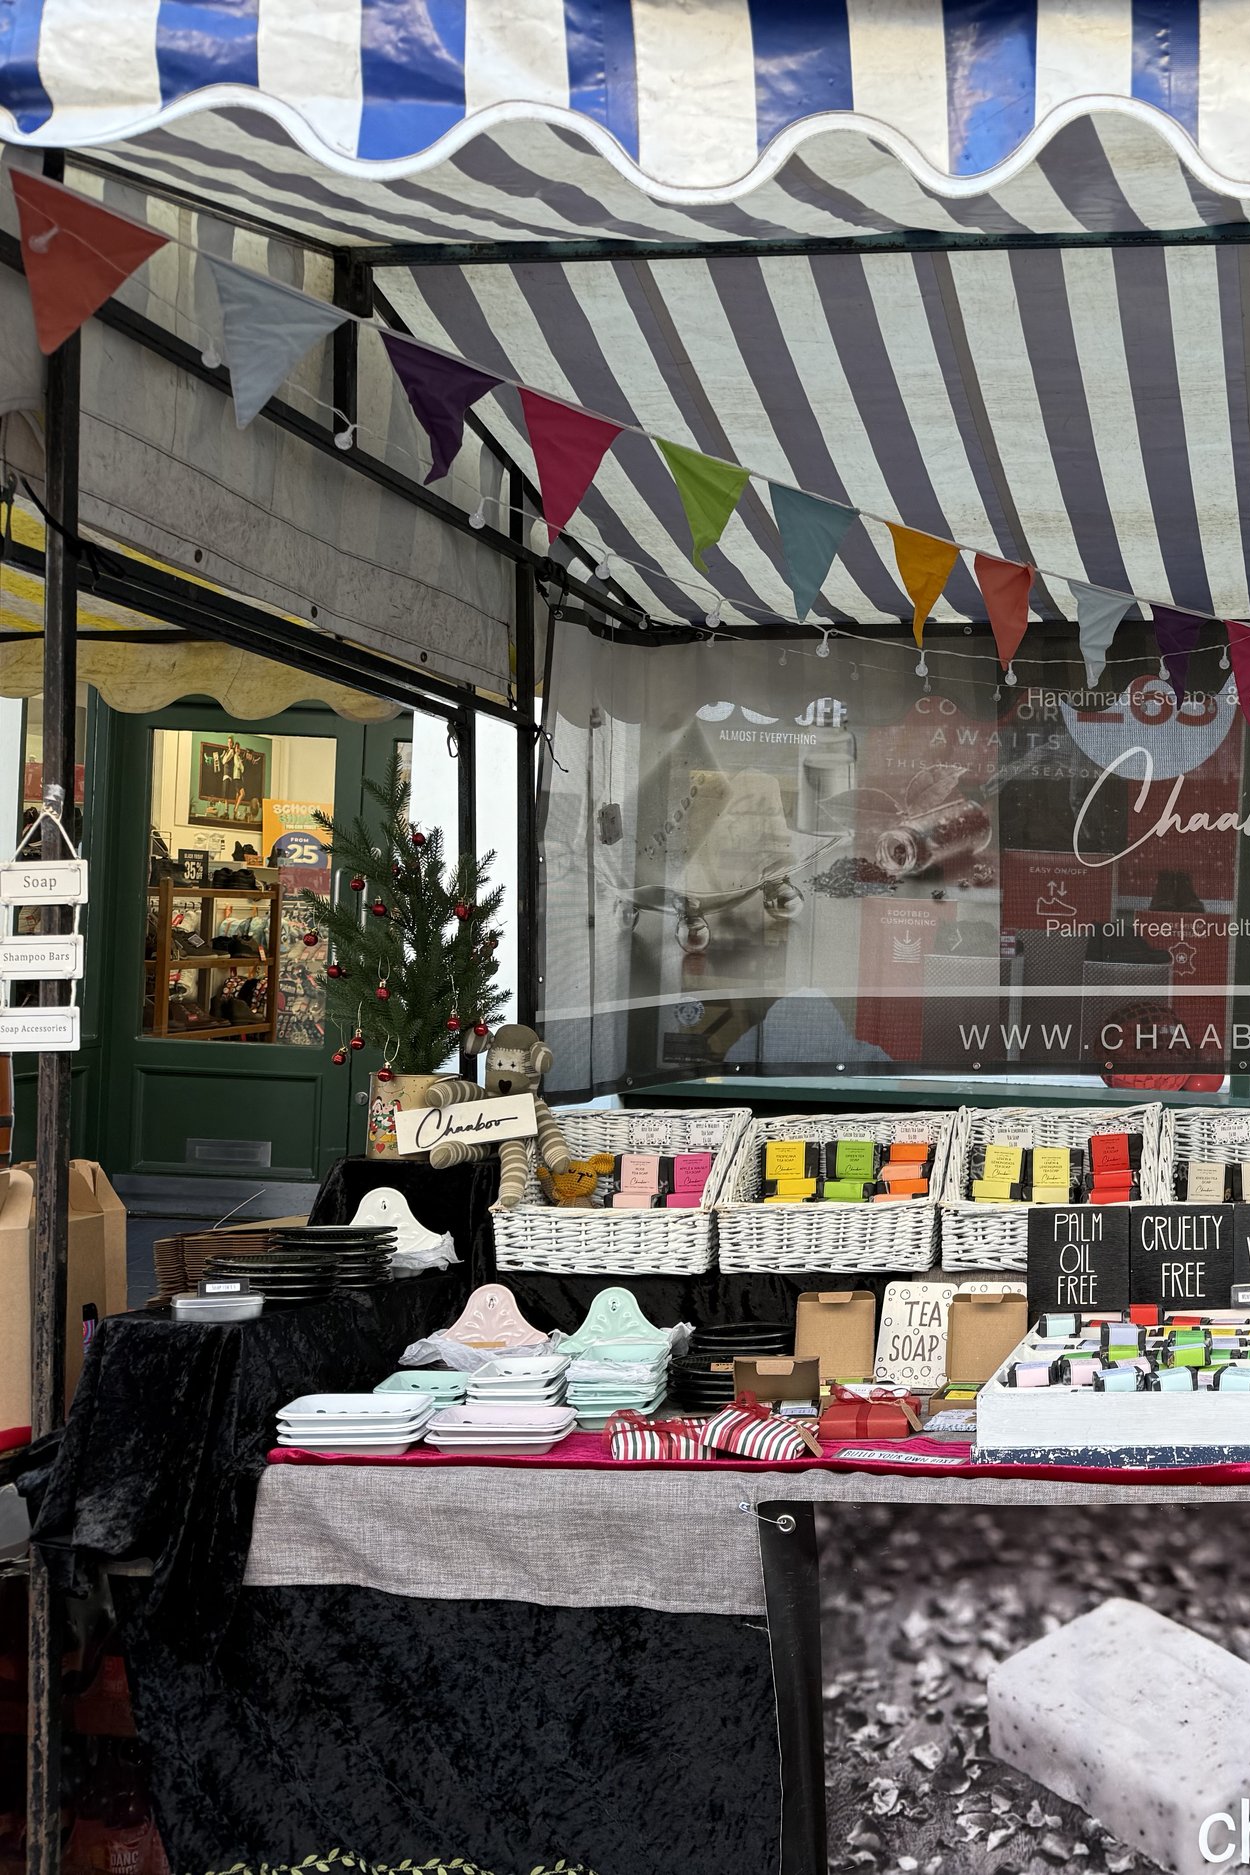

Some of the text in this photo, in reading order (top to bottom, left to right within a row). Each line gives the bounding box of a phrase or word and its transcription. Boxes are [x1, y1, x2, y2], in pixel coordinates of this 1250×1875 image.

[1028, 687, 1143, 707] Handmade
[719, 730, 817, 745] ALMOST EVERYTHING
[931, 728, 1061, 750] AWAITS
[885, 758, 927, 769] THIS
[1029, 866, 1088, 876] EASY ON/OFF
[23, 875, 57, 890] Soap
[1046, 919, 1096, 937] Palm
[1103, 918, 1124, 937] oil
[1132, 919, 1172, 937] free
[3, 951, 70, 963] Shampoo Bars
[0, 1024, 67, 1033] Soap Accessories
[416, 1108, 518, 1149] Chaaboo
[1054, 1212, 1102, 1242] PALM
[1141, 1215, 1223, 1251] CRUELTY
[1059, 1244, 1095, 1274] OIL
[1057, 1275, 1098, 1305] FREE
[1161, 1262, 1206, 1298] FREE
[904, 1300, 942, 1328] TEA
[888, 1335, 940, 1362] SOAP
[844, 1450, 876, 1458] BUILD
[878, 1452, 901, 1460] YOUR
[904, 1455, 931, 1463] OWN
